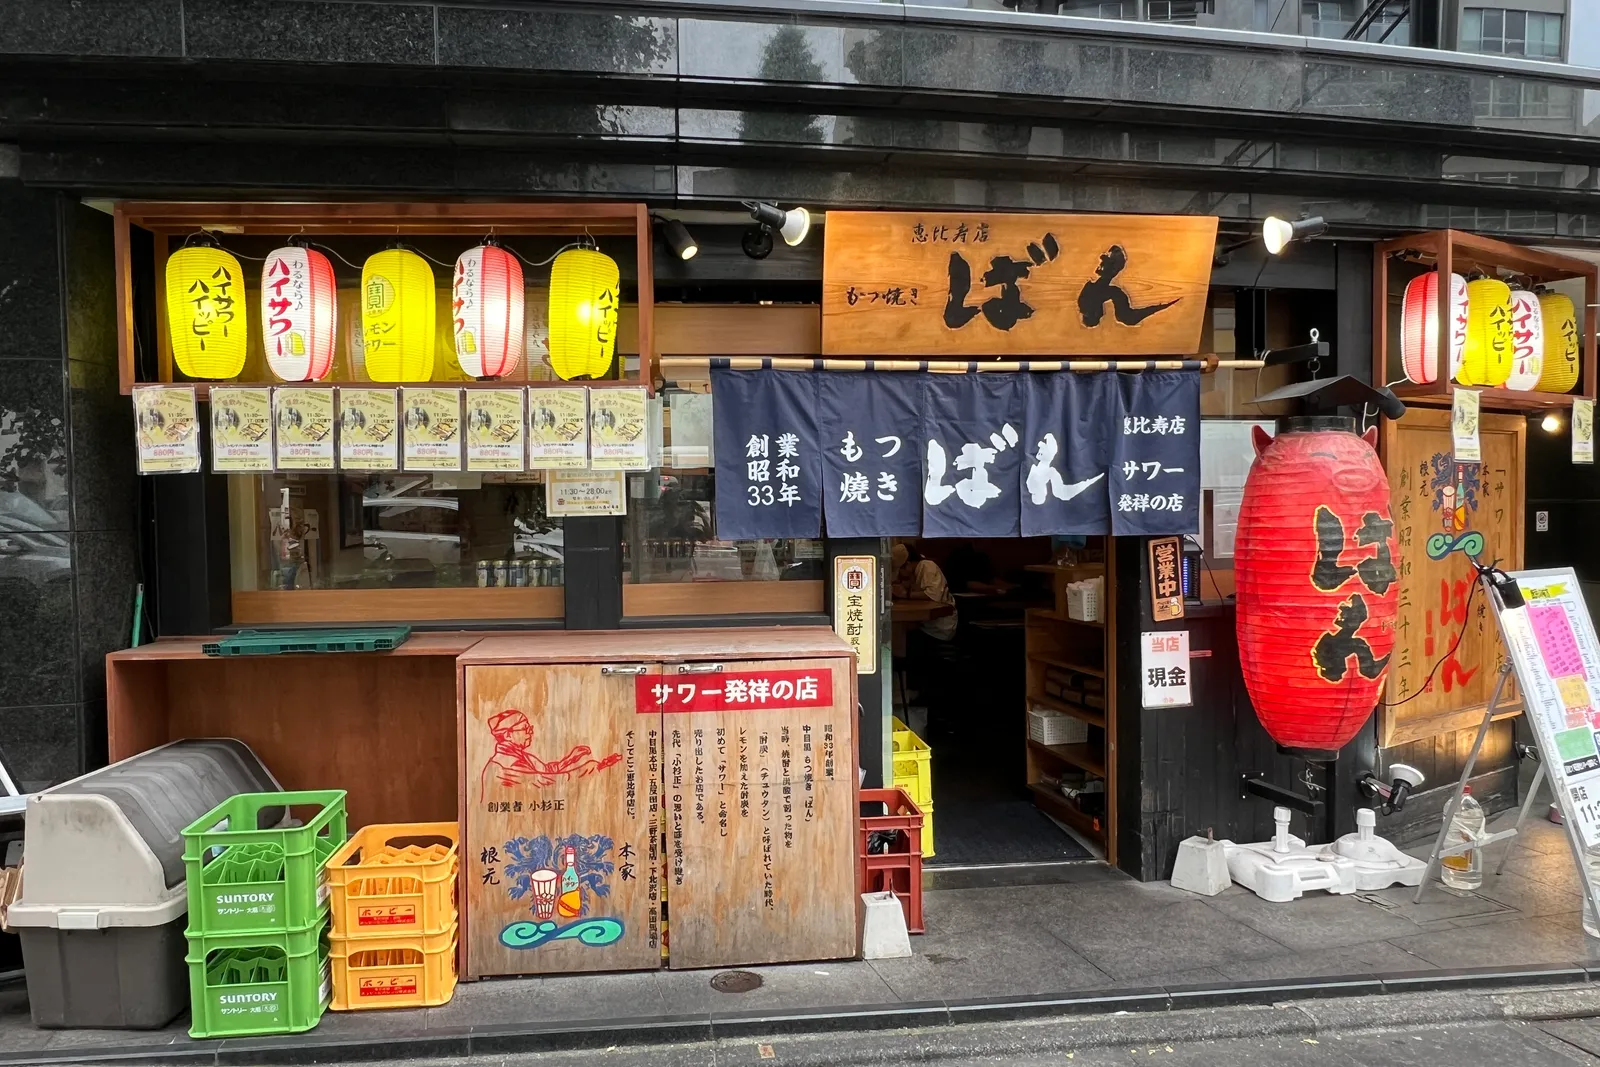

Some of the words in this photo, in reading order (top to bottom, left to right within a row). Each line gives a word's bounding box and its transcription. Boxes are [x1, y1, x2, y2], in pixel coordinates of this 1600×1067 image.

[912, 223, 990, 243] 恵比寿店
[944, 232, 1181, 332] ばん
[212, 265, 235, 337] ハイサワー
[268, 257, 293, 356] ハイサワー
[846, 287, 918, 306] もつ焼き
[188, 279, 213, 351] ハイッピー
[1490, 305, 1506, 364] ハイッピー
[1512, 298, 1534, 375] ハイサワー
[745, 432, 800, 458] 創業
[840, 431, 902, 463] もつ
[746, 458, 801, 482] 昭和
[924, 422, 1106, 509] ばん
[1122, 460, 1185, 481] サワー
[747, 482, 802, 507] 33年
[1117, 493, 1184, 512] 発祥の店
[1155, 544, 1177, 597] 営業中
[846, 595, 864, 636] 宝焼酎
[1151, 637, 1180, 653] 当店
[651, 675, 818, 705] サワー発祥の店
[1148, 666, 1187, 688] 現金
[487, 801, 523, 813] 創業者
[528, 799, 565, 812] 小杉正
[480, 846, 501, 886] 根元
[618, 842, 636, 881] 本家
[216, 893, 275, 904] SUNTORY
[217, 907, 245, 915] サントリー
[219, 992, 278, 1004] SUNTORY
[221, 1007, 247, 1015] サントリー
